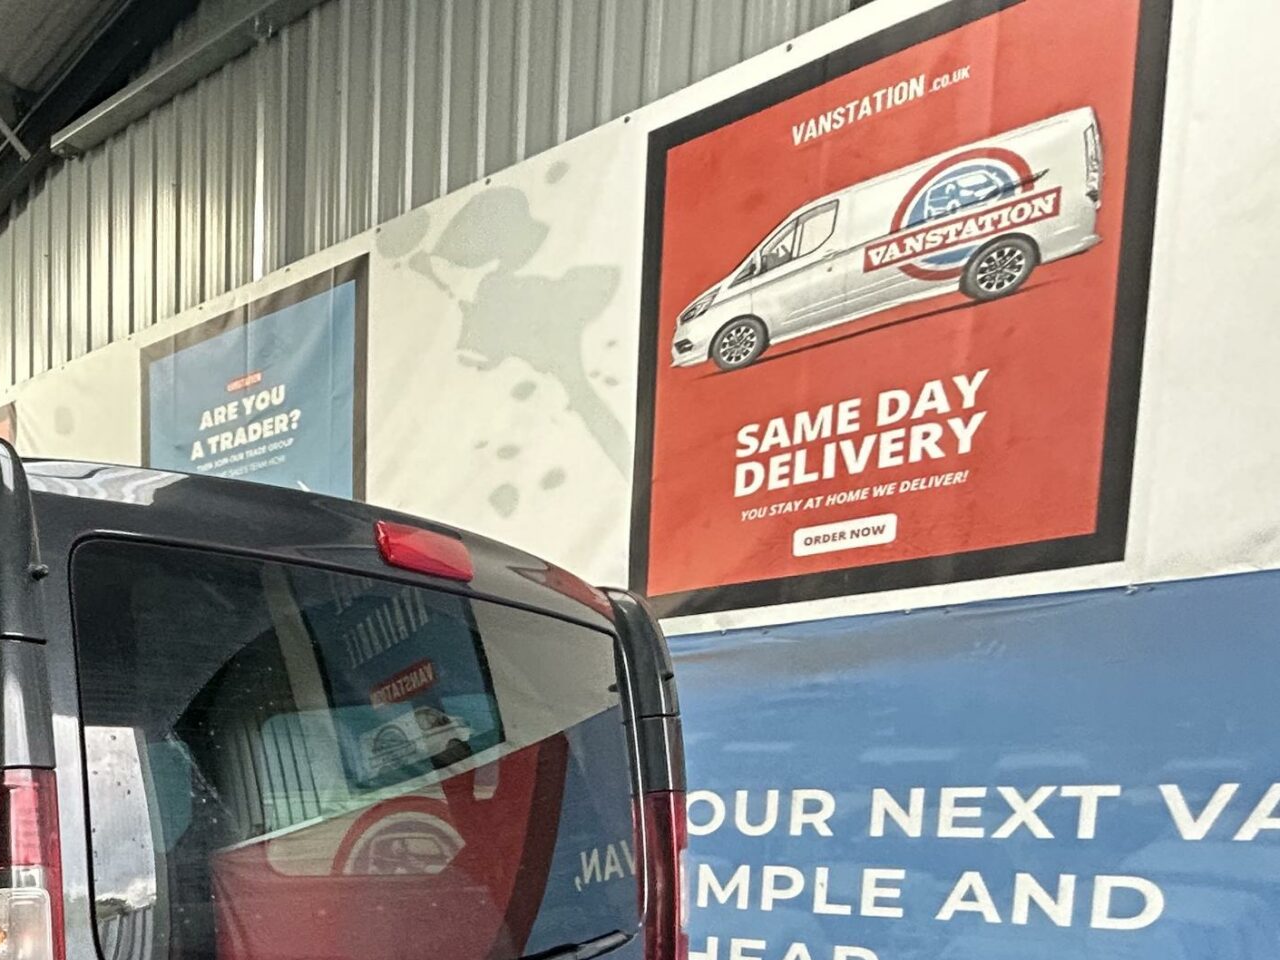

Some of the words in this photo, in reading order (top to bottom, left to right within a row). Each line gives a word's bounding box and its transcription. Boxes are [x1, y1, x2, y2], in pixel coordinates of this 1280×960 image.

[792, 74, 926, 146] VANSTATION
[867, 192, 1058, 267] VANSTATION
[191, 440, 205, 461] A
[207, 409, 301, 455] TRADER?
[199, 401, 239, 431] ARE
[242, 384, 286, 415] YOU
[735, 397, 862, 458] SAME
[877, 368, 990, 427] DAY
[733, 411, 987, 498] DELIVERY
[740, 506, 768, 522] YOU
[768, 500, 802, 517] STAY
[803, 495, 824, 511] AT
[825, 487, 871, 507] HOME
[871, 482, 898, 498] WE
[898, 470, 970, 494] DELIVER!
[803, 531, 847, 547] ORDER
[849, 524, 887, 540] NOW
[869, 785, 1122, 839] NEXT
[935, 871, 1165, 930] AND
